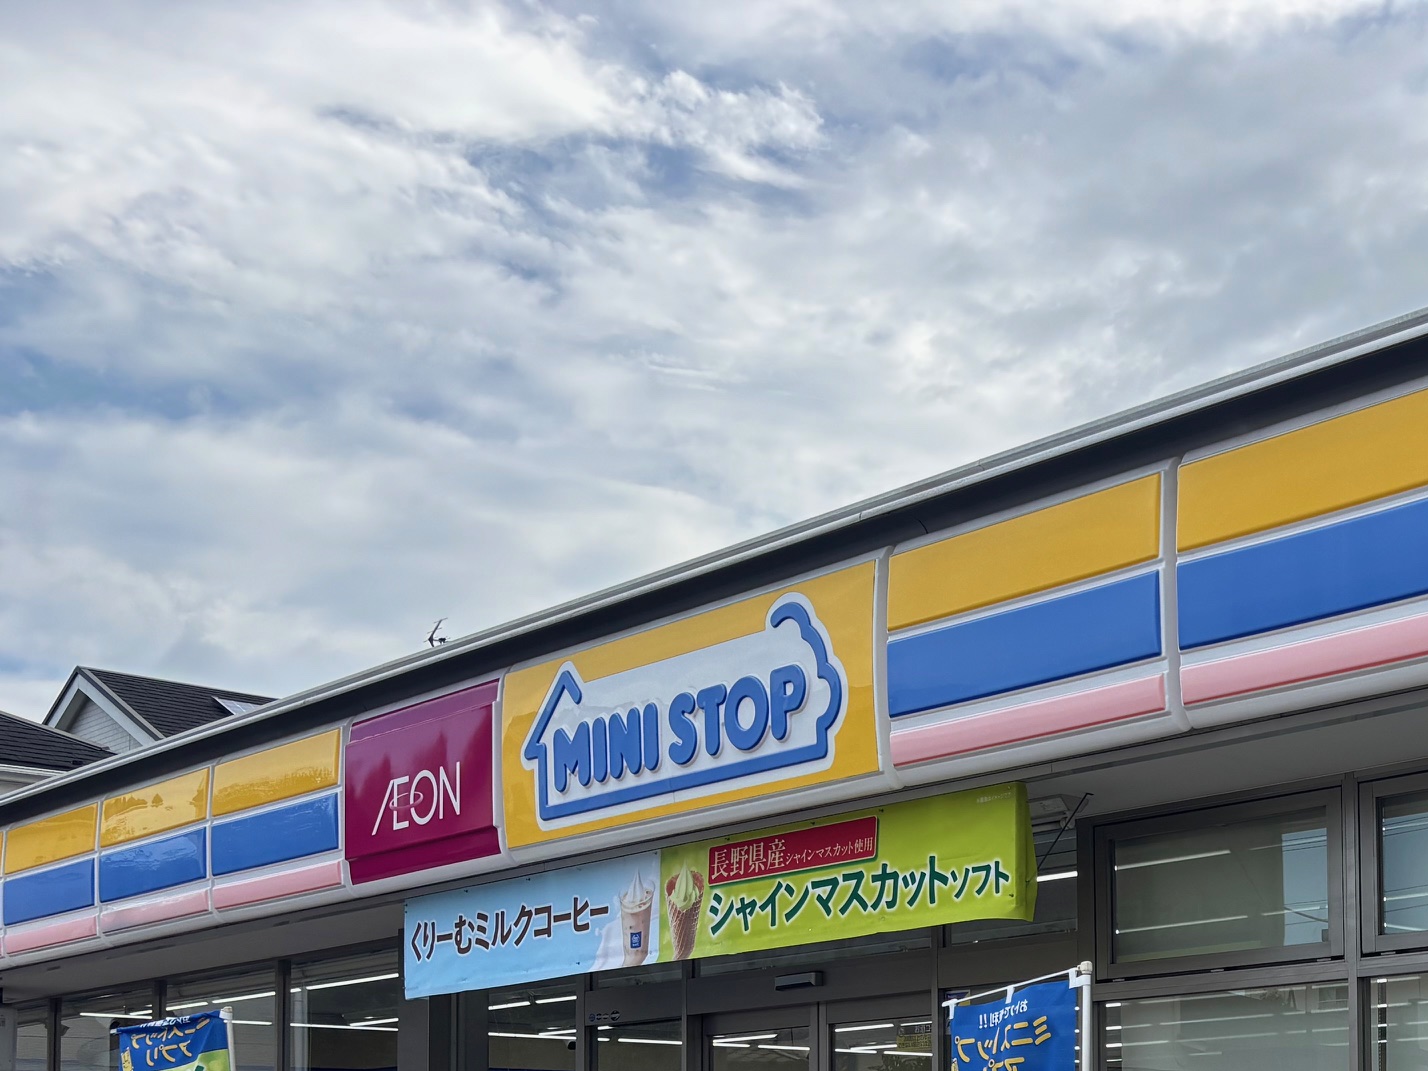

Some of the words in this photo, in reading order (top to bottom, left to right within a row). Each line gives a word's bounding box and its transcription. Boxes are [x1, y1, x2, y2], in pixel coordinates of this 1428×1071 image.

[553, 702, 660, 794] MINI
[668, 664, 806, 766] STOP
[710, 838, 786, 880] 長野県産
[785, 836, 873, 866] シャインマスカット使用
[410, 896, 609, 963] くりーむミルクコーヒー
[708, 855, 1010, 935] シャインマスカットソフト
